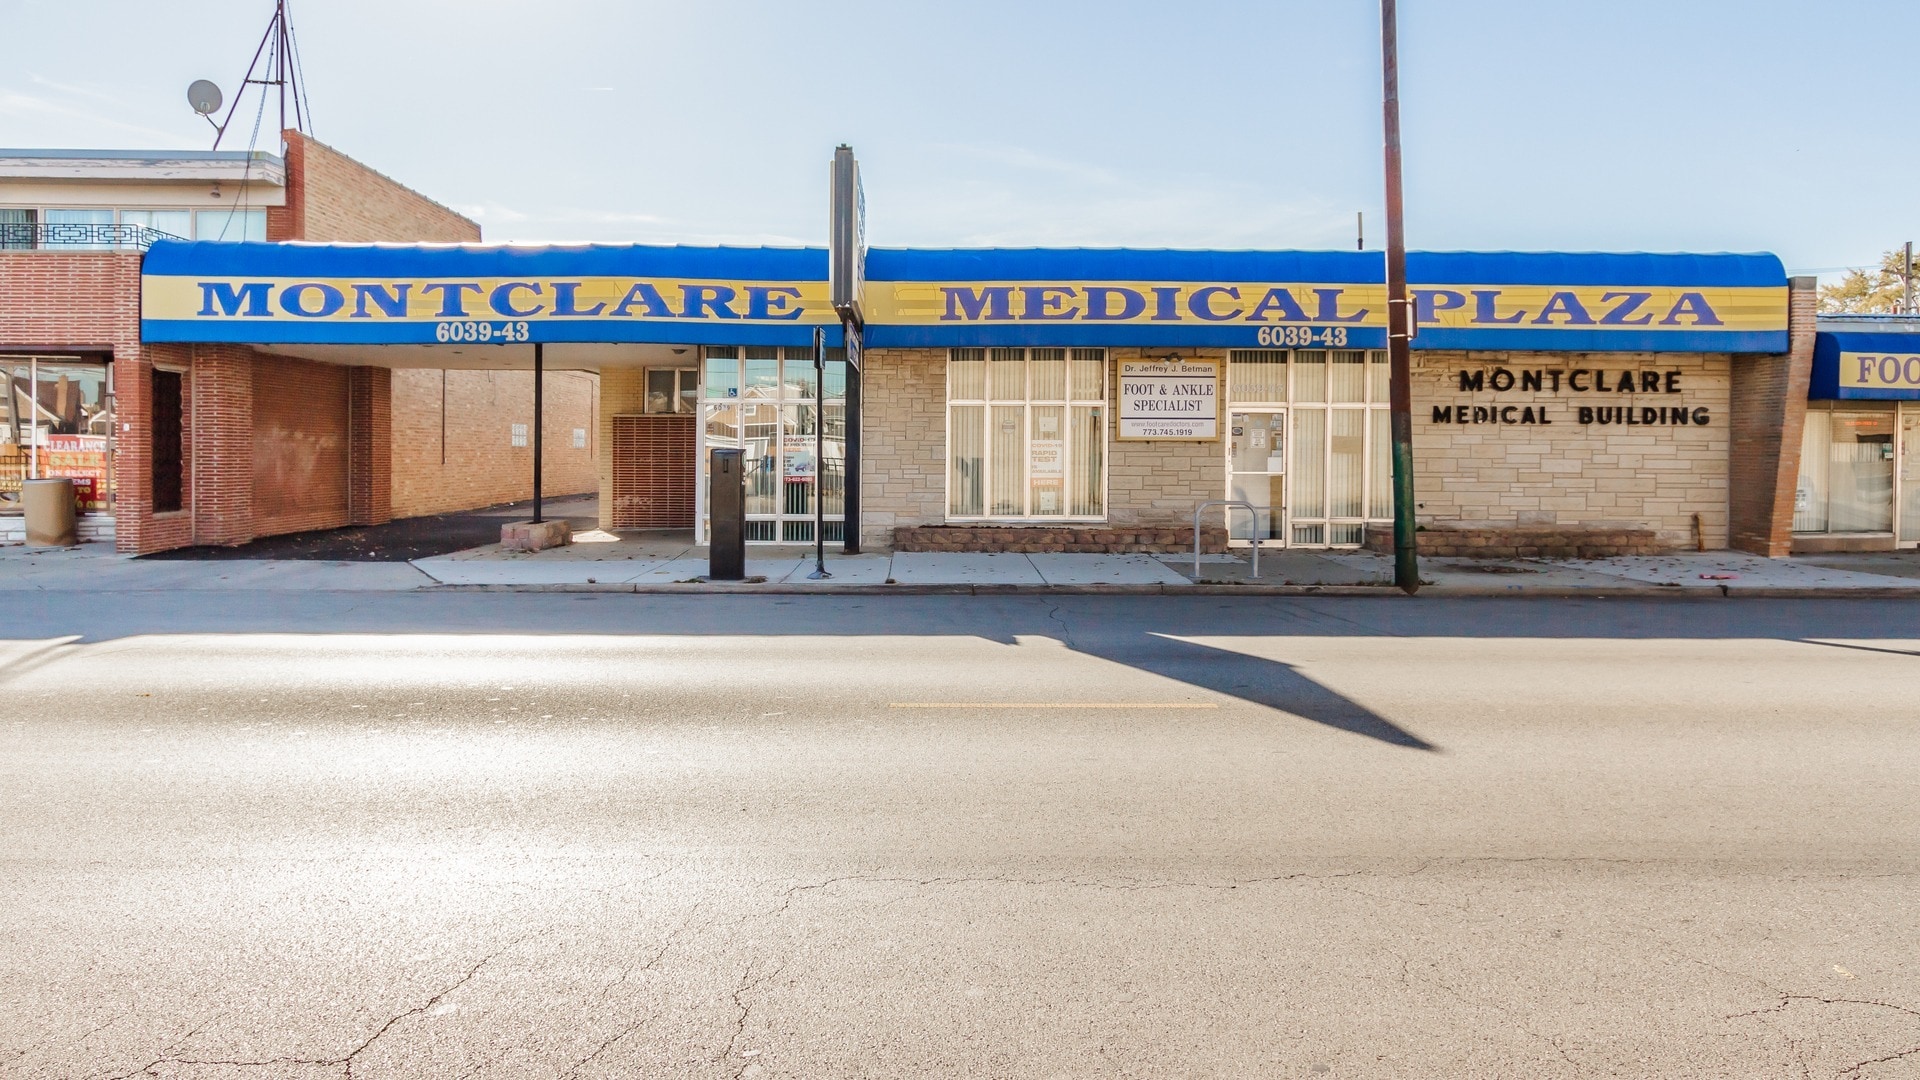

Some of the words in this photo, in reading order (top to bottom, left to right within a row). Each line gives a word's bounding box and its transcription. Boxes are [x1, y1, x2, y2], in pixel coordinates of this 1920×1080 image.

[197, 281, 805, 320] MONTCLARE
[939, 286, 1370, 323] MEDICAL
[1410, 289, 1724, 326] PLAZA
[435, 321, 530, 342] 6039-43
[1257, 326, 1348, 347] 6039-43
[1139, 365, 1168, 373] Jeffrey
[1171, 365, 1178, 373] J.
[1181, 365, 1213, 373] Betman
[1857, 356, 1920, 385] FOO
[1459, 368, 1683, 393] MONTCLARE
[1124, 383, 1155, 395] FOOT
[1159, 383, 1168, 396] &
[1172, 384, 1214, 396] ANKLE
[1133, 399, 1203, 411] SPECIALIST
[1432, 405, 1552, 425] MEDICAL
[1578, 406, 1710, 426] BUILDING
[1142, 428, 1193, 436] 773.745.1919
[43, 440, 107, 452] CLEARANCE
[50, 453, 101, 466] SALE
[64, 469, 102, 477] SELECT
[72, 478, 92, 486] EMS
